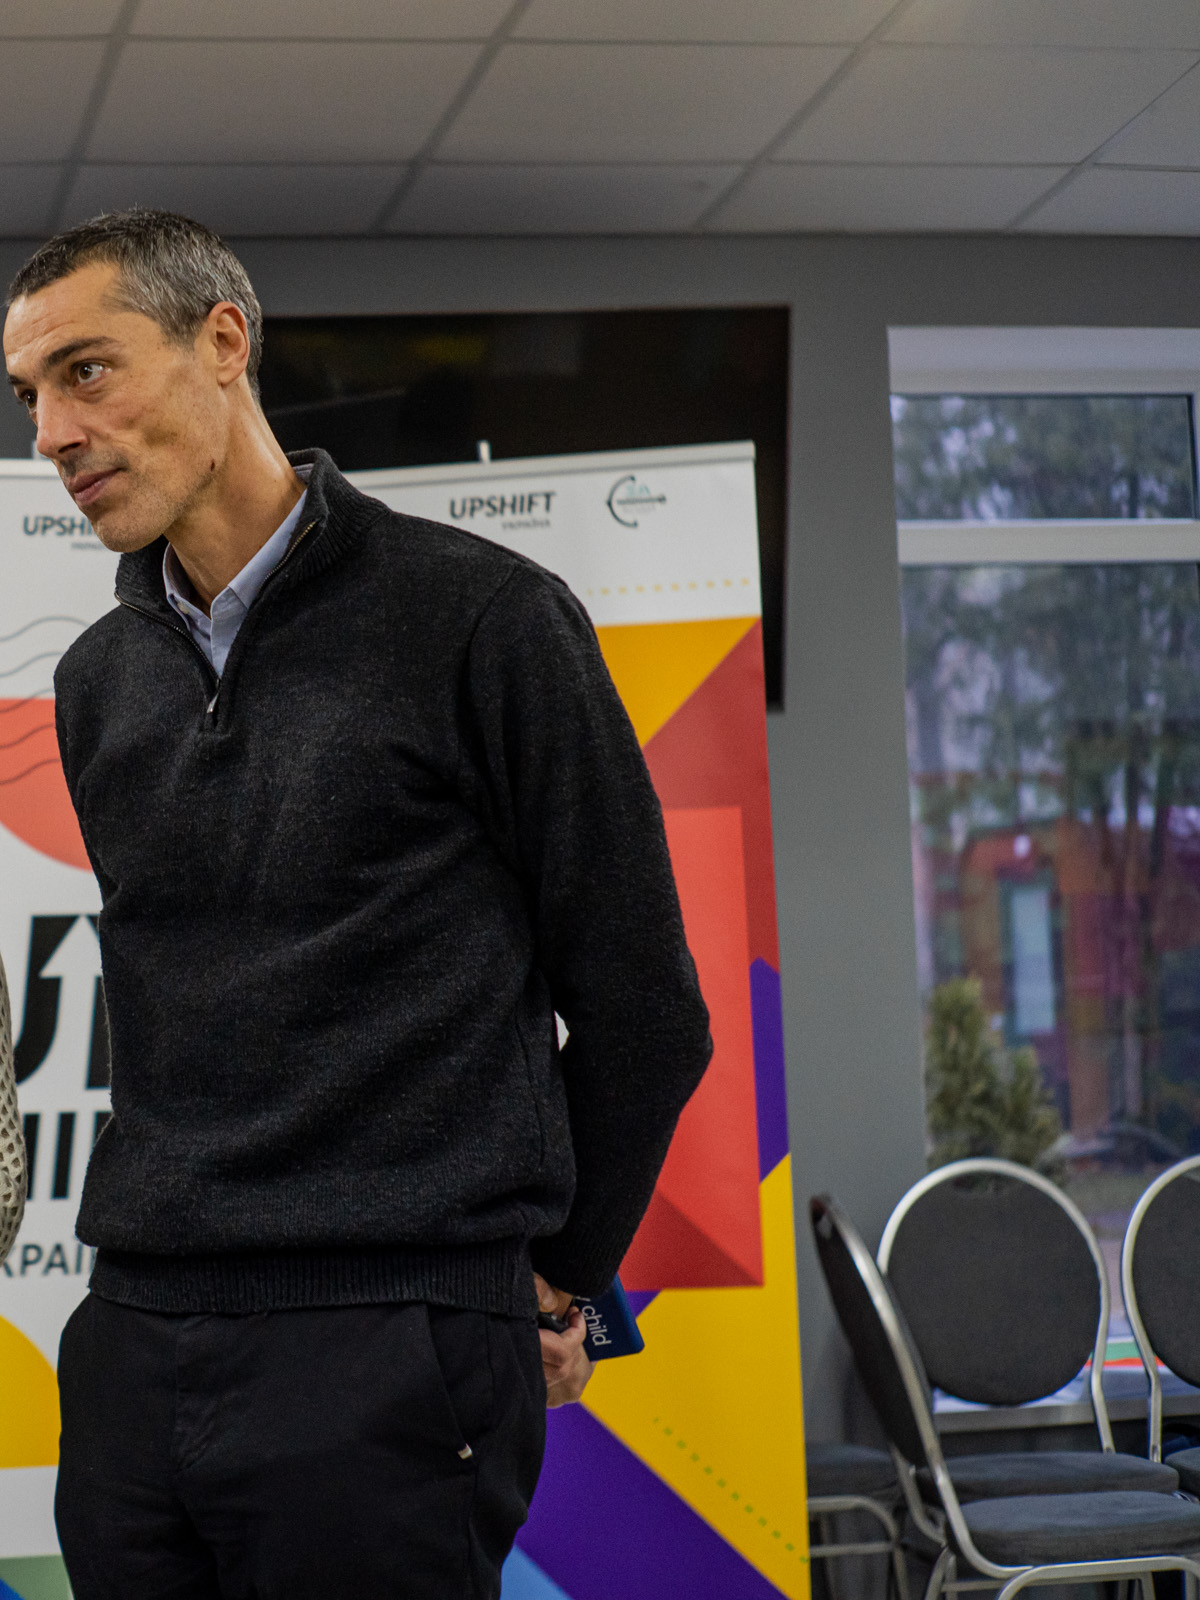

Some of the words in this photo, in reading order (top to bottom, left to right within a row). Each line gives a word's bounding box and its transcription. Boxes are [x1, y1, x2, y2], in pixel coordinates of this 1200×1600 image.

[450, 491, 557, 519] UPSHIFT
[23, 516, 95, 536] UPSHI
[581, 1305, 612, 1347] child
